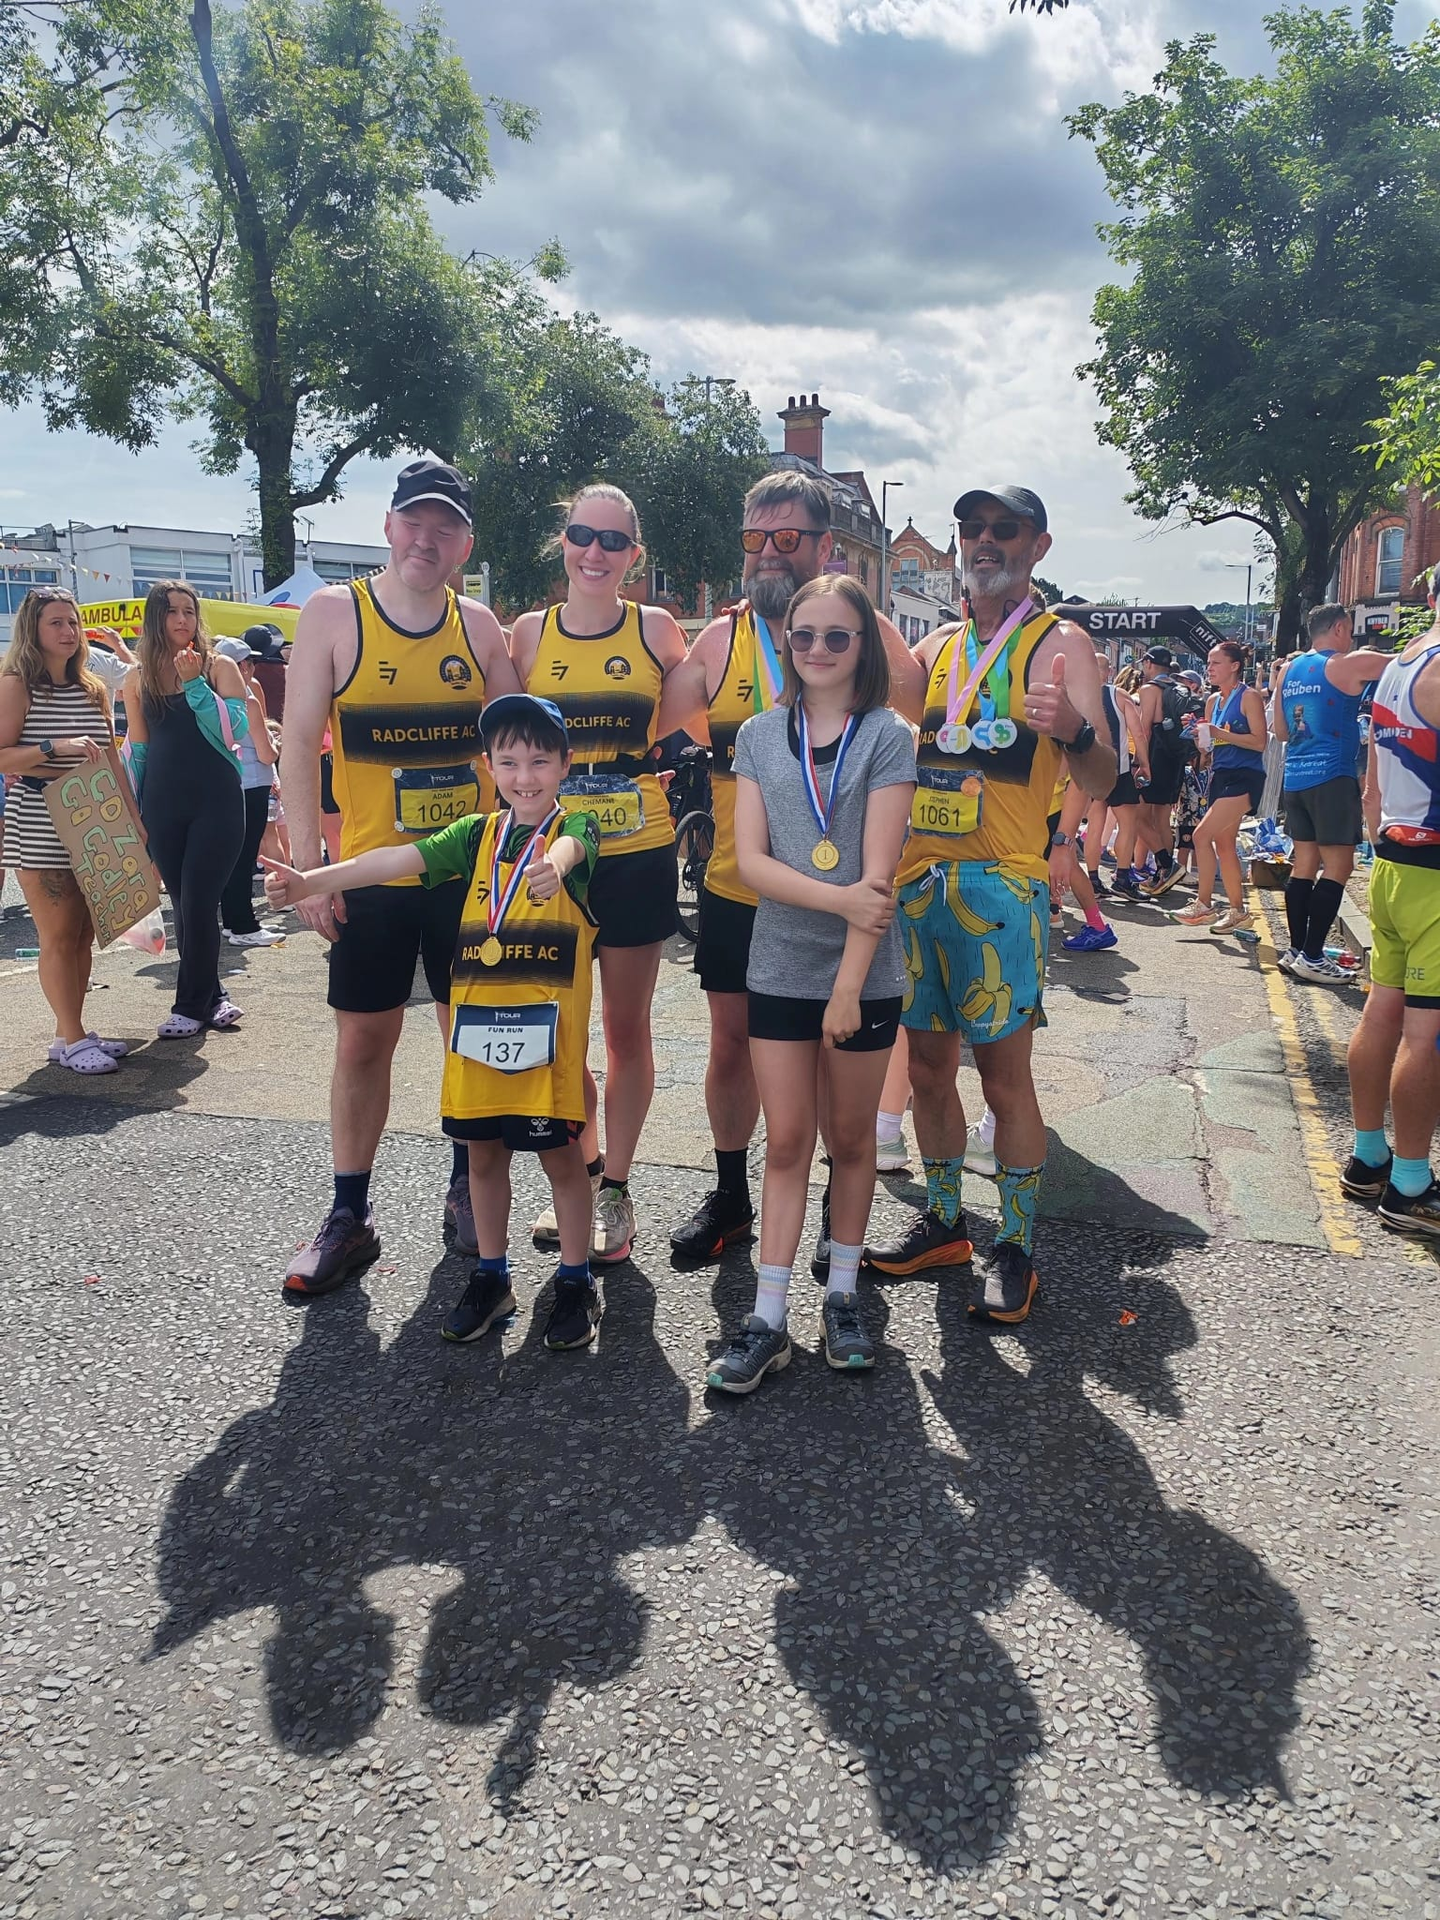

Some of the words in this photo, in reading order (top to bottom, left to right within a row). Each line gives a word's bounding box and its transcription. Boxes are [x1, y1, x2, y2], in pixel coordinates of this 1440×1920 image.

[81, 605, 143, 625] AMBULA
[1089, 611, 1162, 630] START
[1282, 684, 1321, 698] Reuben
[1287, 680, 1301, 688] For
[565, 716, 613, 729] DCLIFFE
[615, 717, 631, 727] AC
[372, 726, 459, 742] RADCLIFFE
[462, 725, 476, 738] AC
[432, 792, 454, 800] ADAM
[417, 800, 467, 823] 1042
[588, 807, 627, 827] 40
[919, 804, 960, 827] 1061
[82, 824, 136, 932] Godley
[111, 823, 149, 914] Zara
[462, 944, 533, 961] RADIFFE
[537, 946, 559, 961] AC
[482, 1041, 526, 1064] 137
